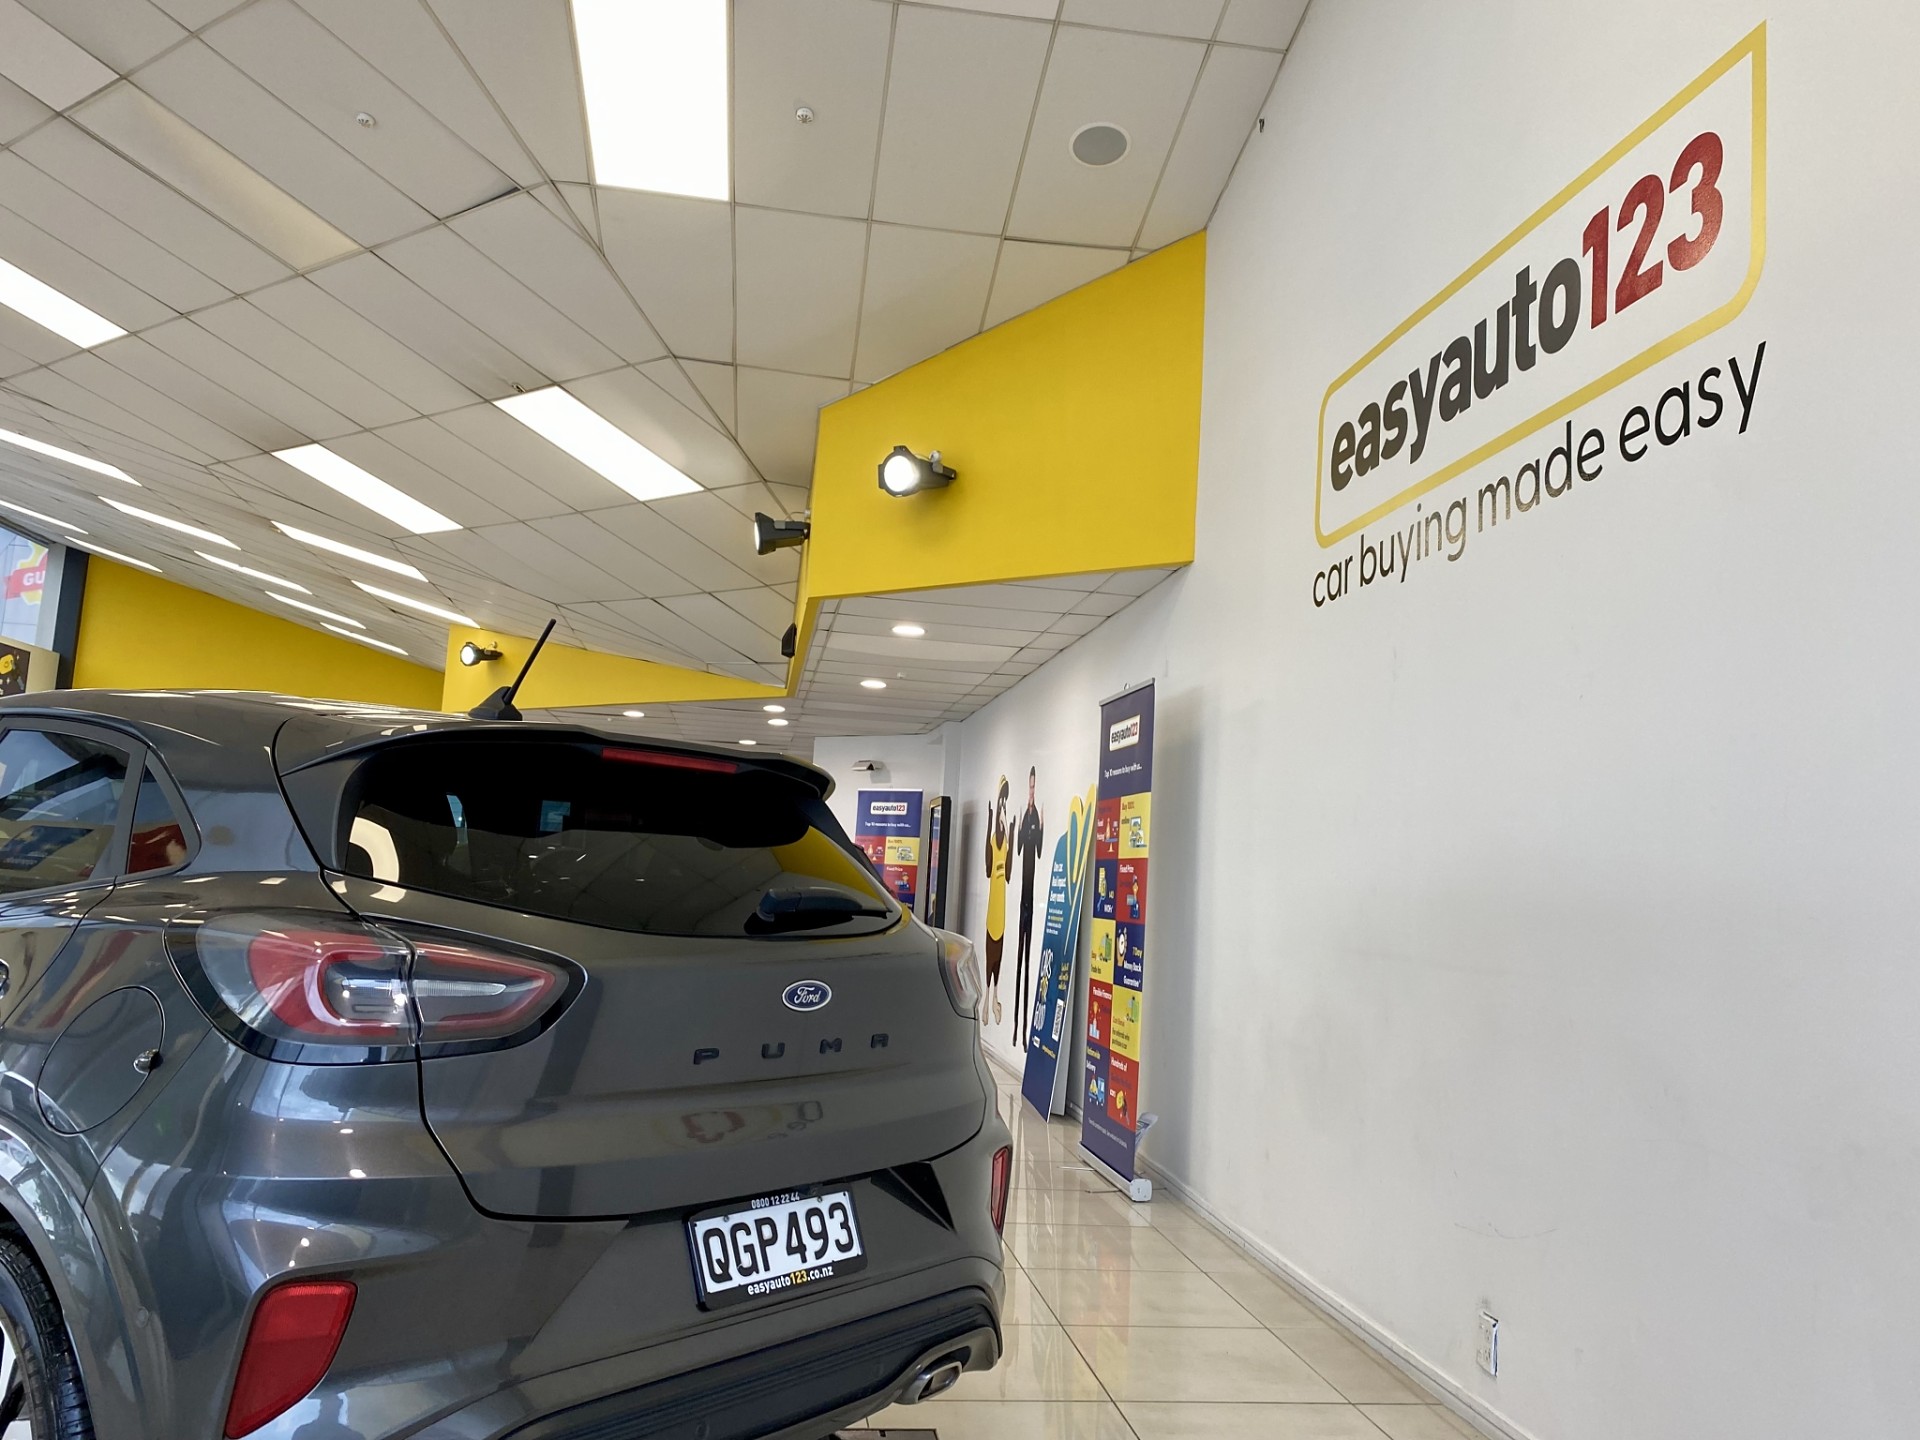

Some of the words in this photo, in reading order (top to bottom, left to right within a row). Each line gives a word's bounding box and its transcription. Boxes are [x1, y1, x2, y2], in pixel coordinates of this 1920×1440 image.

[1331, 132, 1723, 492] easyauto123
[1312, 556, 1354, 608] car
[1359, 503, 1468, 584] buying
[1477, 420, 1605, 534] made
[1619, 340, 1767, 464] easy
[1111, 721, 1138, 744] easyauto123
[872, 804, 906, 812] easyauto123
[794, 986, 821, 1004] Ford
[693, 1033, 889, 1065] PUMA
[751, 1198, 770, 1209] 0800
[771, 1196, 780, 1206] 12
[780, 1194, 790, 1204] 22
[790, 1192, 800, 1202] 44
[747, 1266, 834, 1295] easyauto123.co.nz
